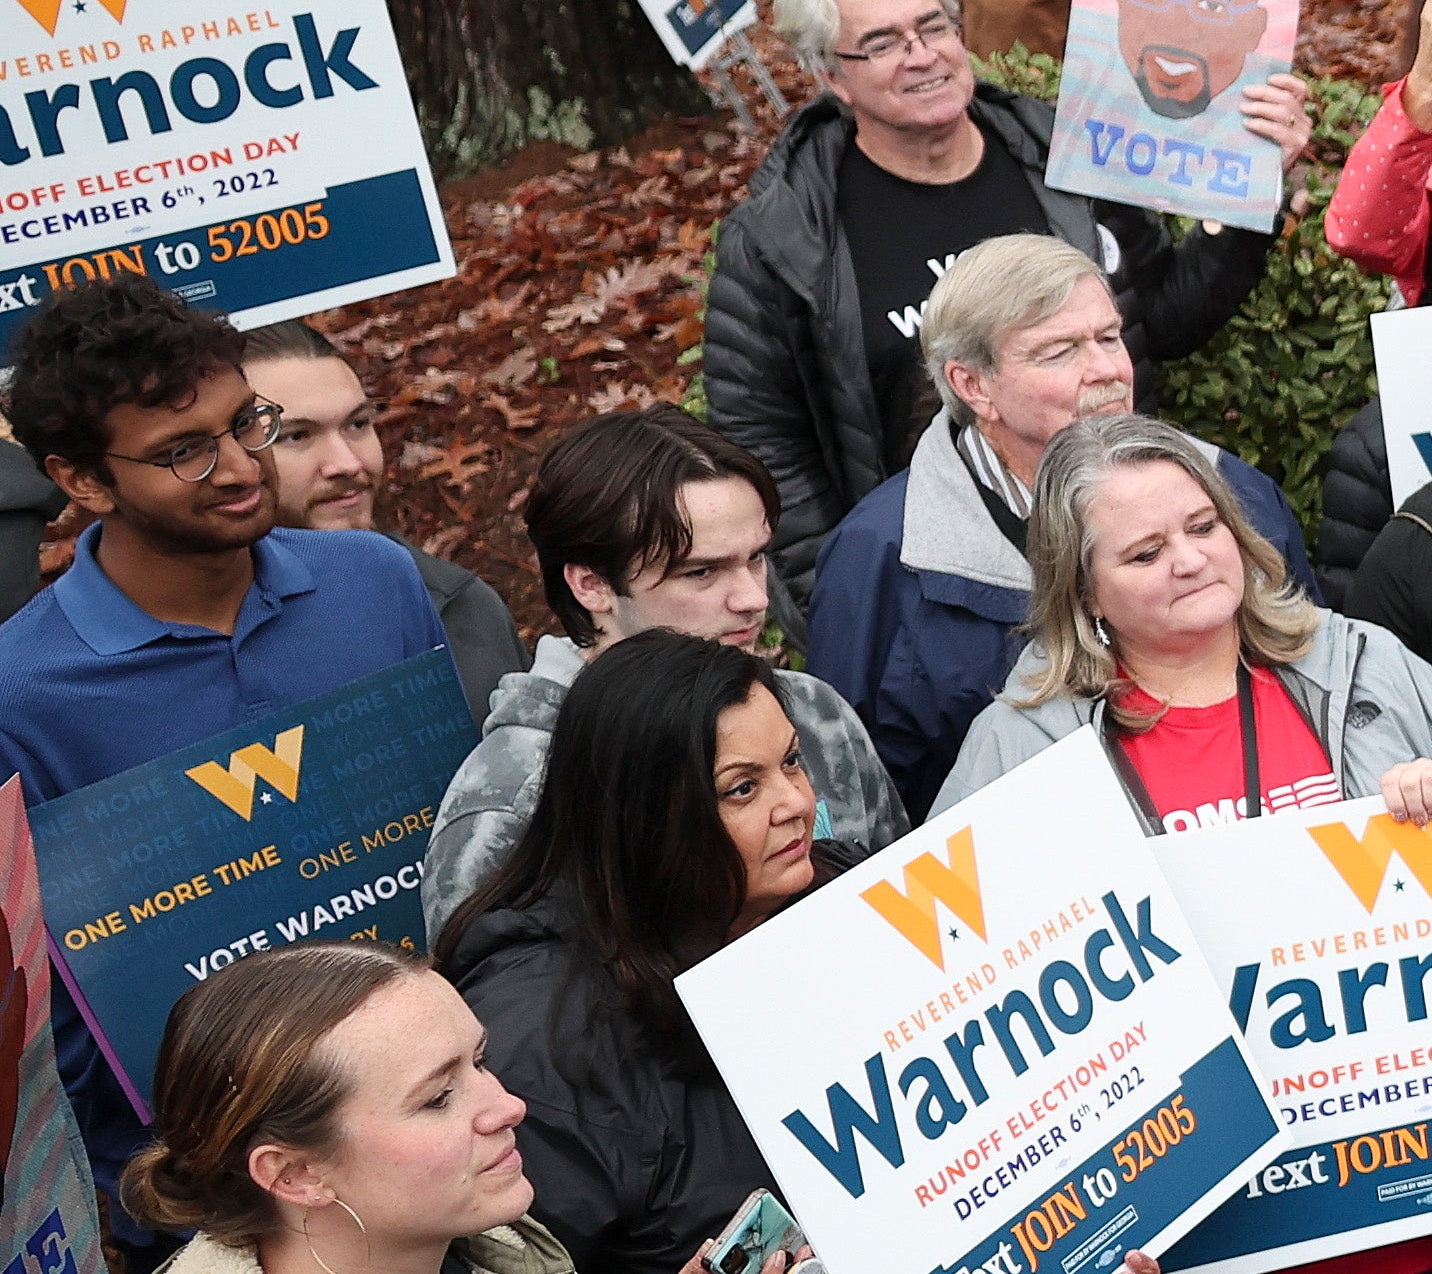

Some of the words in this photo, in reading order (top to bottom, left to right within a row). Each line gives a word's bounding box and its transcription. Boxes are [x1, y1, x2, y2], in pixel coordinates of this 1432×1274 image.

[138, 9, 280, 55] RAPHAEL
[79, 146, 234, 197] ELECTION
[242, 132, 301, 163] DAY
[214, 169, 278, 199] 2022
[1084, 120, 1252, 200] VOTE
[154, 235, 200, 277] to
[208, 203, 329, 263] 52005
[63, 912, 127, 951] ONE
[128, 874, 213, 924] MORE
[213, 845, 283, 885] TIME
[299, 842, 356, 880] ONE
[883, 963, 997, 1053] REVEREND
[1002, 896, 1096, 970] RAPHAEL
[1271, 918, 1432, 967] REVEREND
[781, 889, 1183, 1199] Warnock
[914, 1127, 1004, 1208] RUNOFF
[1006, 1052, 1108, 1139] ELECTION
[1108, 1021, 1149, 1061] DAY
[952, 1127, 1068, 1221] DECEMBER
[1100, 1066, 1145, 1110] 2022
[1009, 1181, 1085, 1273] JOIN
[1083, 1166, 1117, 1207] to
[1111, 1094, 1197, 1183] 52005
[1333, 1123, 1429, 1187] JOIN
